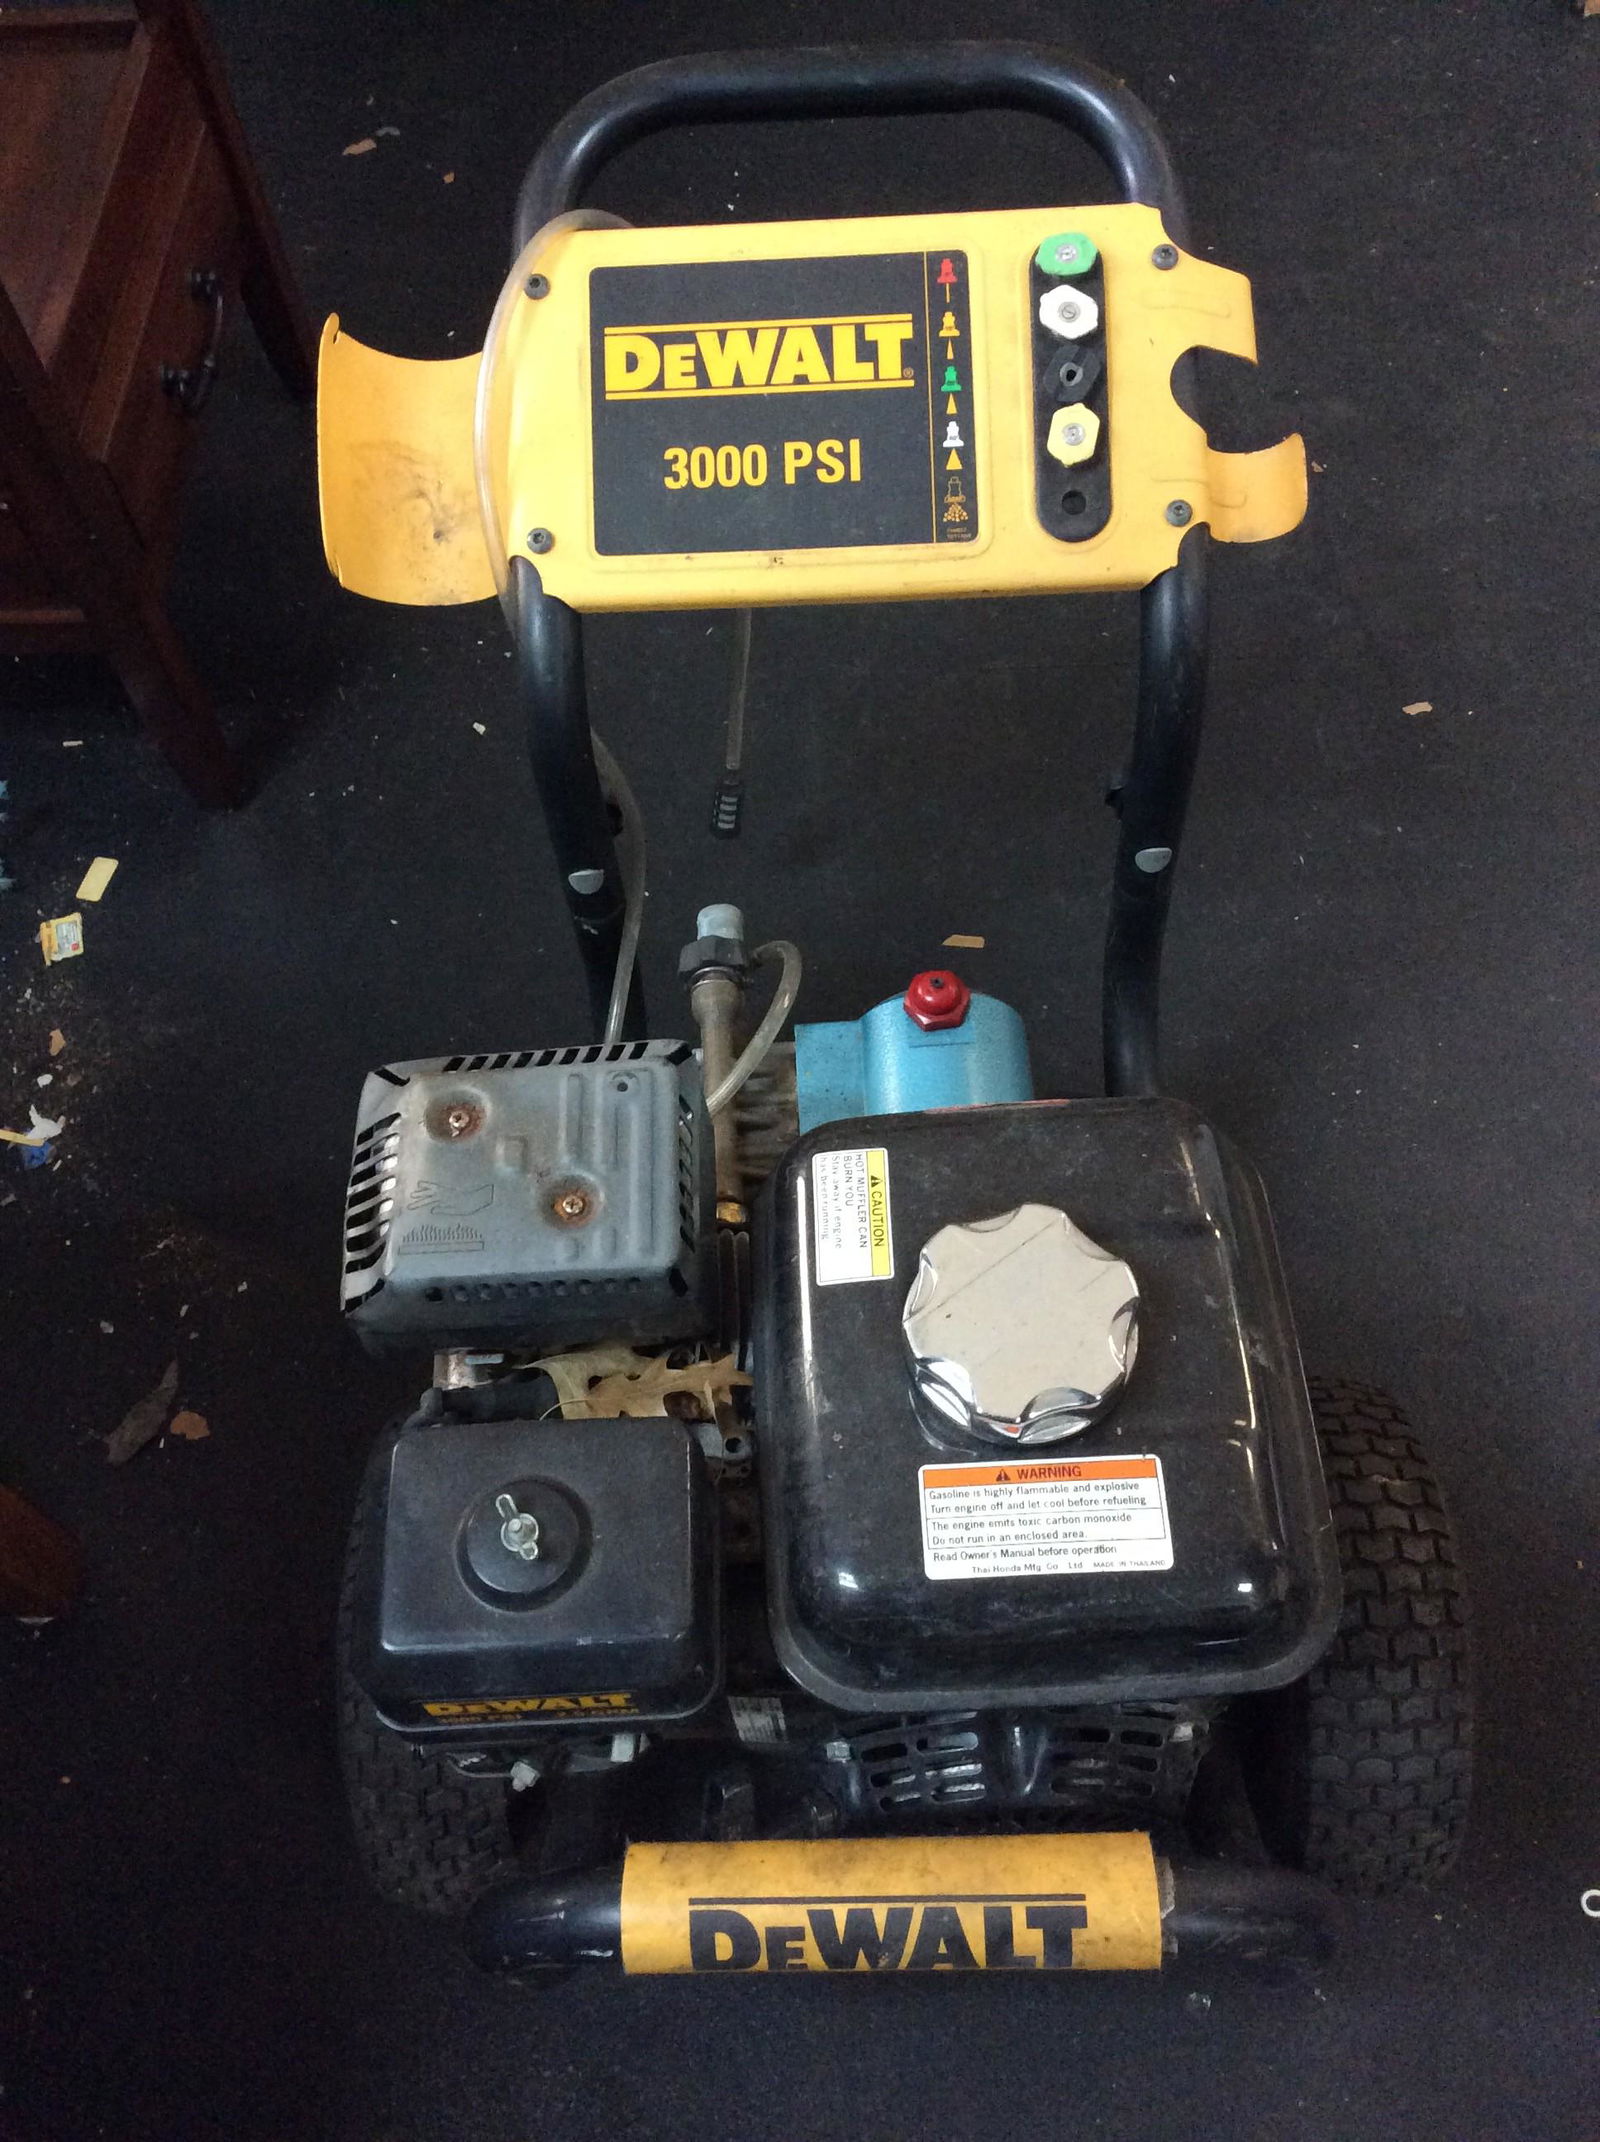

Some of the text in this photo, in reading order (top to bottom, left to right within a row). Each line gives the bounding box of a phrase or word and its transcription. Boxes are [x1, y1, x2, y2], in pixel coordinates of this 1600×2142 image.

[663, 438, 861, 489] 3000 PSI
[832, 1155, 841, 1175] Stay
[843, 1155, 854, 1207] BURN YOU
[832, 1181, 840, 1201] away
[855, 1154, 868, 1248] HOT MUFFLER CAN
[871, 1191, 885, 1247] CAUTION
[833, 1215, 842, 1249] engine
[1017, 1466, 1082, 1480] WARNING
[929, 1489, 970, 1500] Gasoline
[984, 1487, 1013, 1498] highly
[1016, 1484, 1069, 1495] flammable
[1073, 1484, 1091, 1492] and
[1094, 1481, 1140, 1492] explosive
[930, 1495, 1147, 1514] Turn engine off and let cool before refueling
[932, 1513, 1132, 1531] The engine emits toxic carbon monoxide
[932, 1530, 1088, 1545] Do not run in an enclosed area.
[933, 1544, 1117, 1561] Read Owner's Manual before operation
[972, 1566, 991, 1574] Thai
[993, 1564, 1021, 1573] Honda
